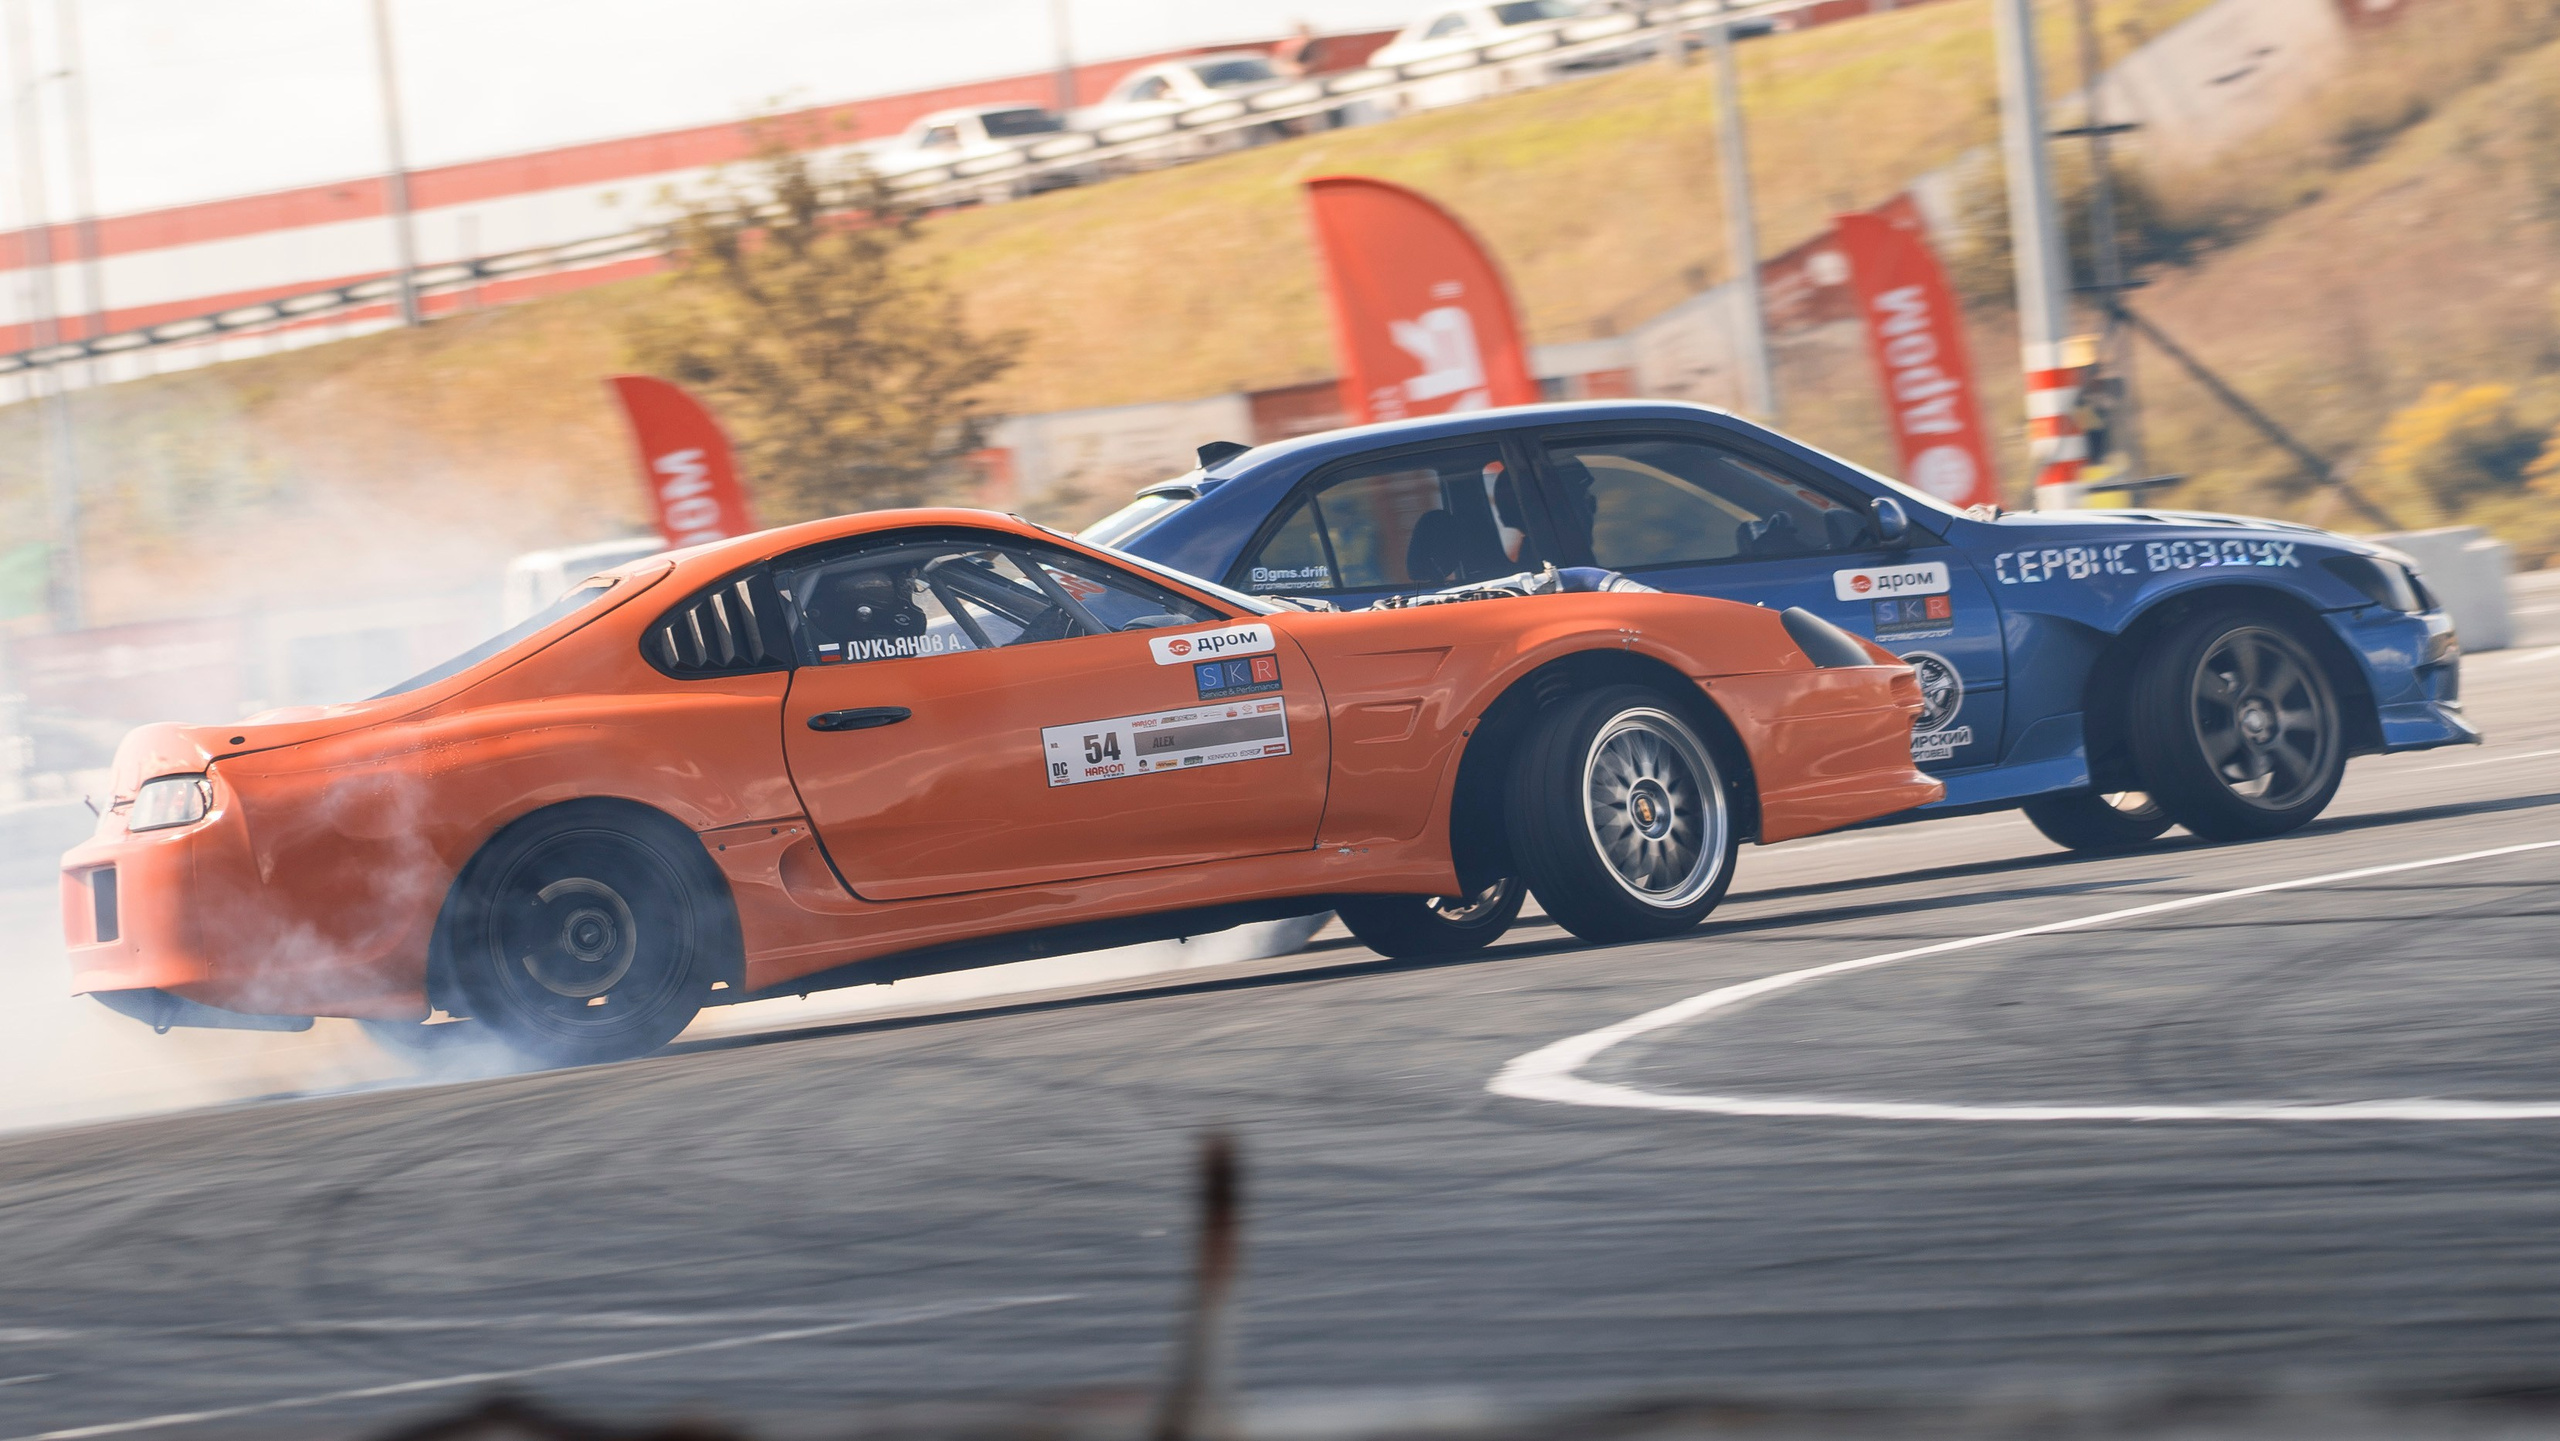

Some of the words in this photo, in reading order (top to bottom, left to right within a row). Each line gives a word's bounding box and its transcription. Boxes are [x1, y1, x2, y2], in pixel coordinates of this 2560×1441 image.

[1994, 546, 2139, 585] СЕРВИС
[1268, 566, 1329, 582] gms.drift
[1878, 571, 1934, 592] дром
[847, 634, 944, 661] ЛУКЬЯНОВ
[1198, 632, 1258, 653] дром
[1201, 690, 1228, 699] Service
[1152, 735, 1175, 749] ALEX
[1910, 729, 1969, 749] ИРСКИЙ
[1083, 732, 1122, 765] 54
[1207, 752, 1238, 761] KENWOOD
[1912, 748, 1949, 759] РГОВЕЦ
[1052, 762, 1069, 777] DC
[1085, 764, 1126, 777] HARSON
